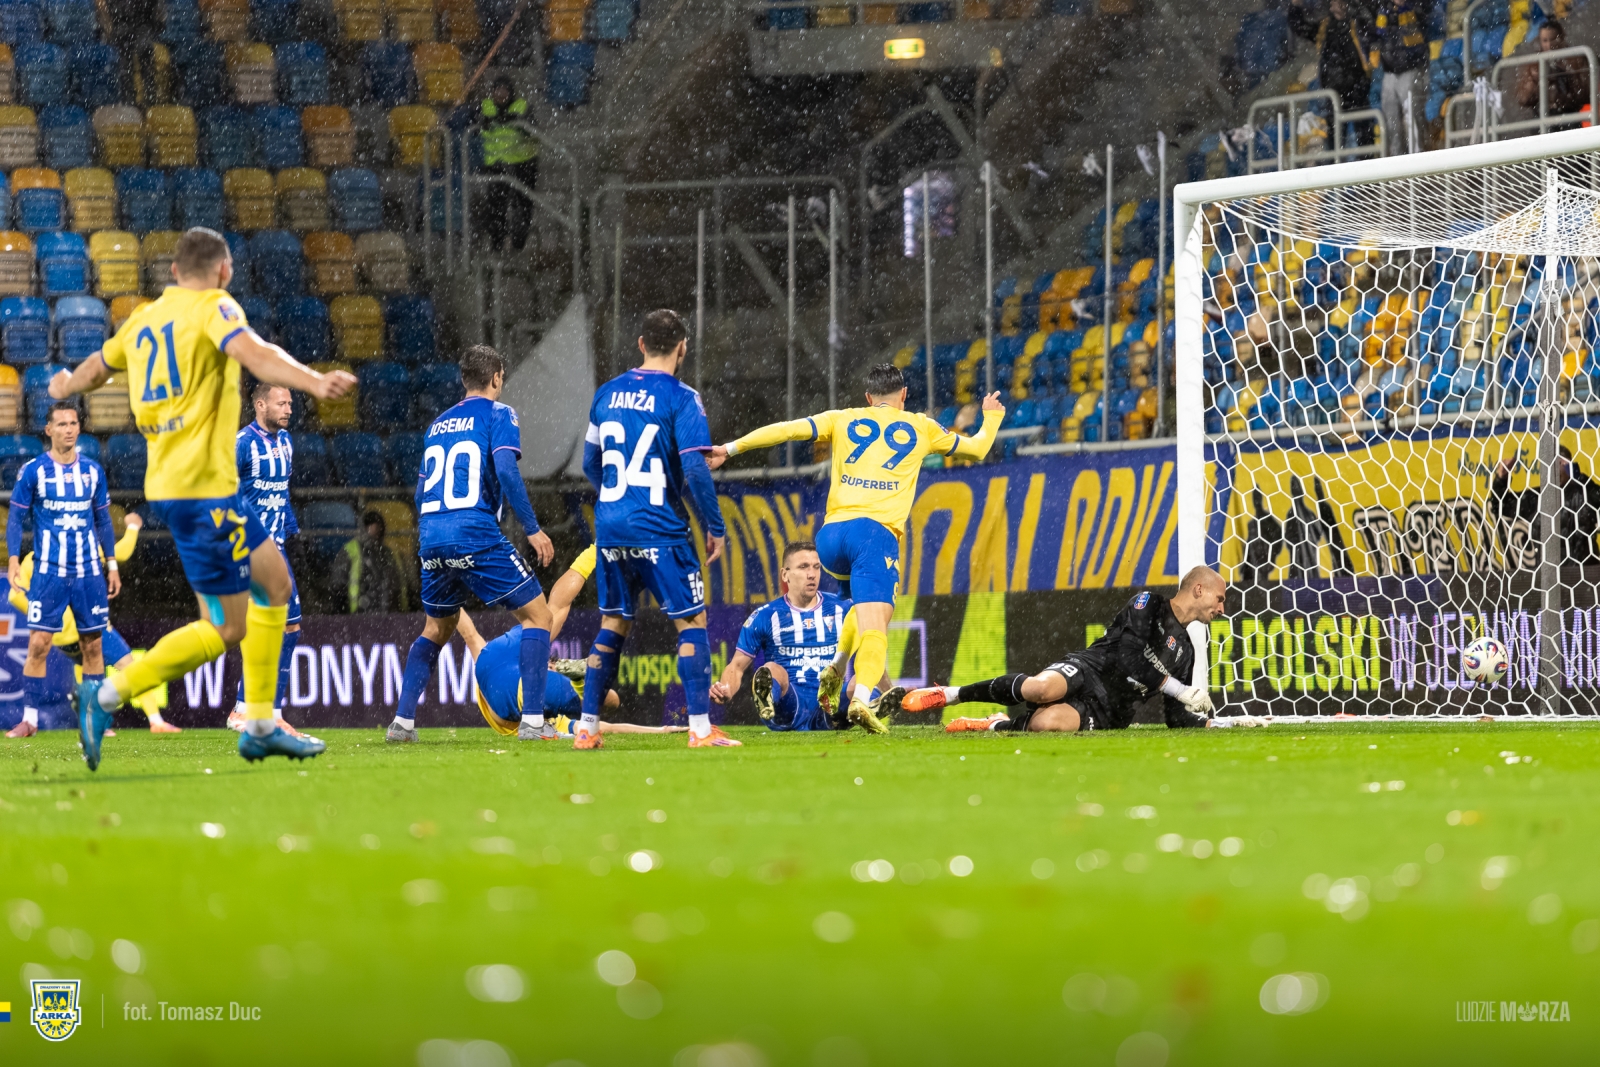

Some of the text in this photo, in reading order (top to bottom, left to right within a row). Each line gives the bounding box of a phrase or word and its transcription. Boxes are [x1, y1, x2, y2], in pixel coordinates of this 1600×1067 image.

[136, 320, 183, 402] 21
[428, 416, 474, 438] JOSEMA
[607, 389, 655, 413] JANŽA
[599, 421, 667, 507] 64
[844, 418, 918, 471] 99
[420, 440, 481, 515] 20
[840, 473, 900, 491] SUPERBET
[1241, 615, 1381, 693] POLSKI
[1389, 611, 1418, 691] W
